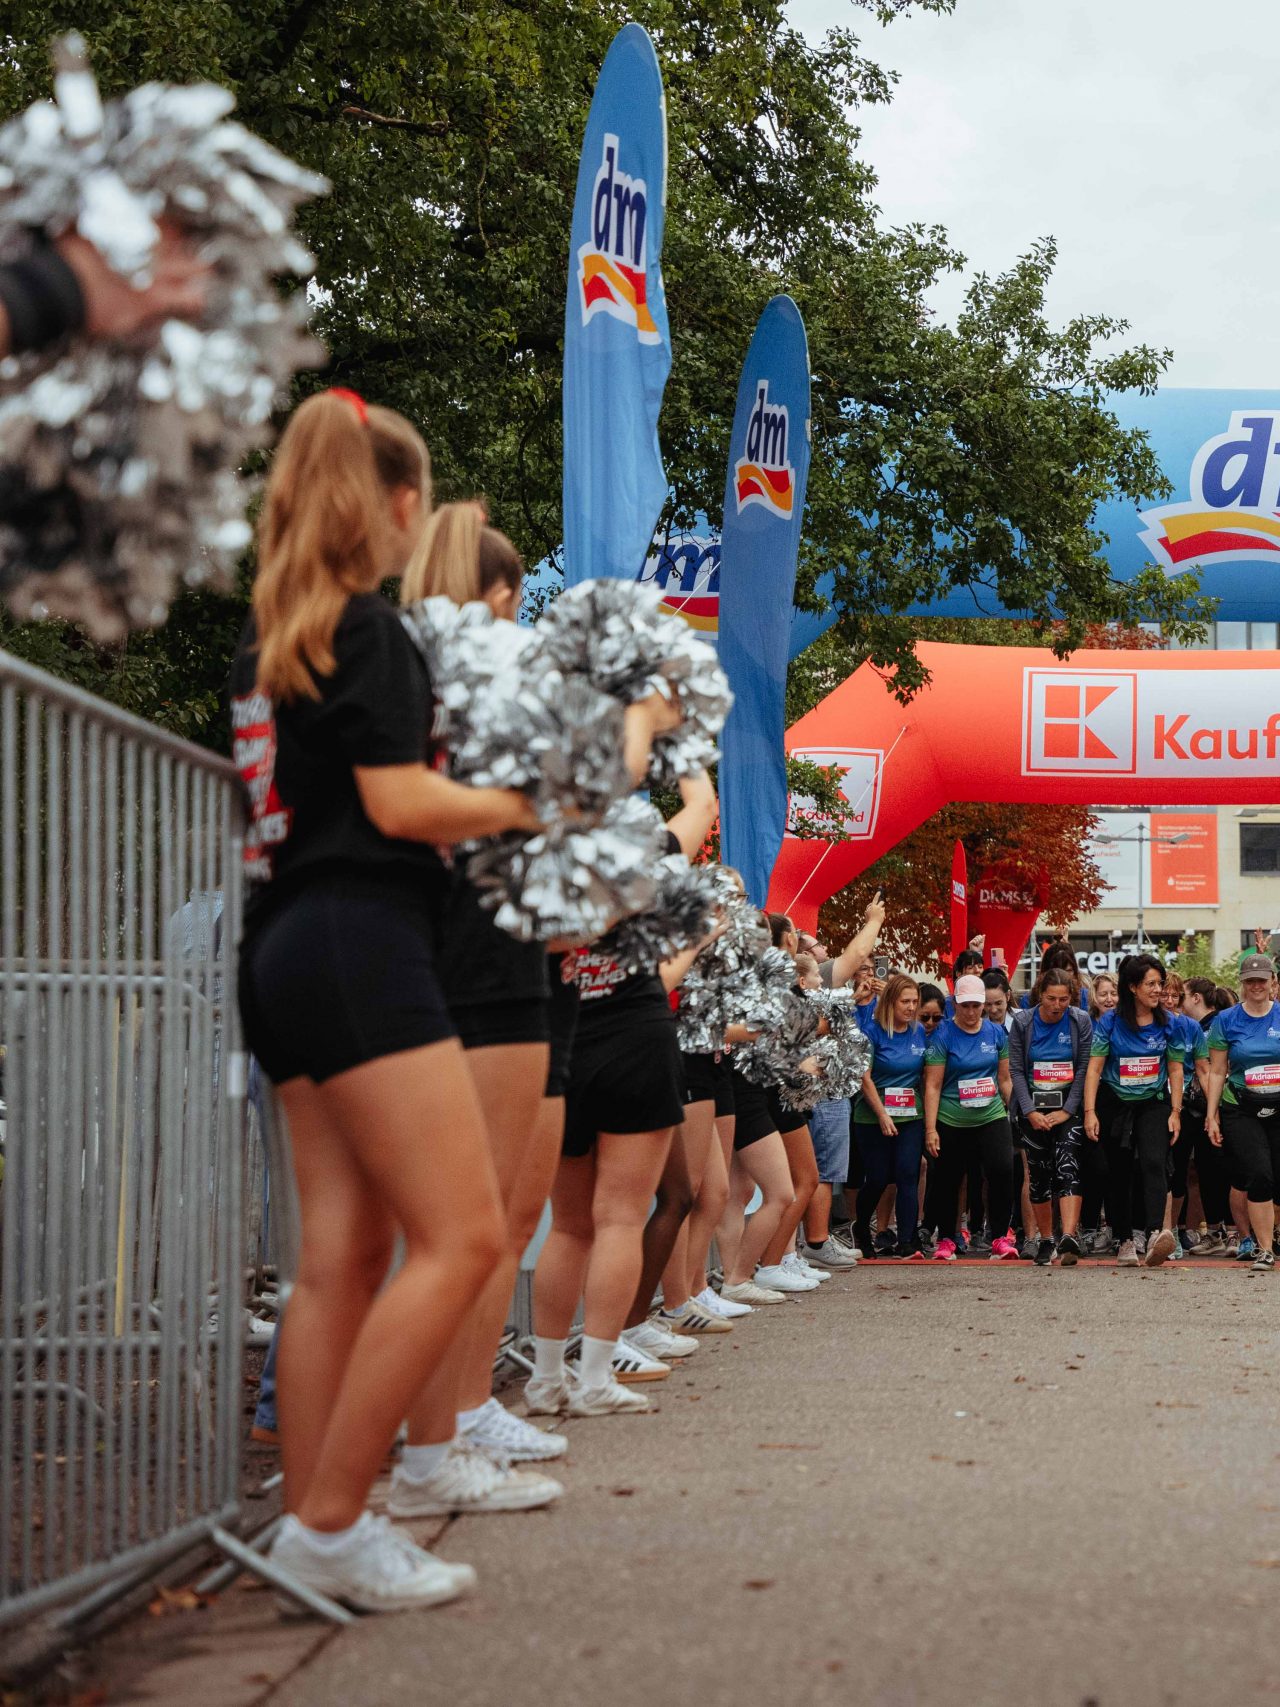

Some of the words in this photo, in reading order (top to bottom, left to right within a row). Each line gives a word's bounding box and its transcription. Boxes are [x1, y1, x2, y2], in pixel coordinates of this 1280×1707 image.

[593, 147, 646, 265] dm
[747, 389, 786, 466] dm
[1128, 1064, 1153, 1072] Sabine
[1040, 1069, 1067, 1077] Simone
[1252, 1073, 1280, 1081] Adriana
[962, 1085, 993, 1095] Christine
